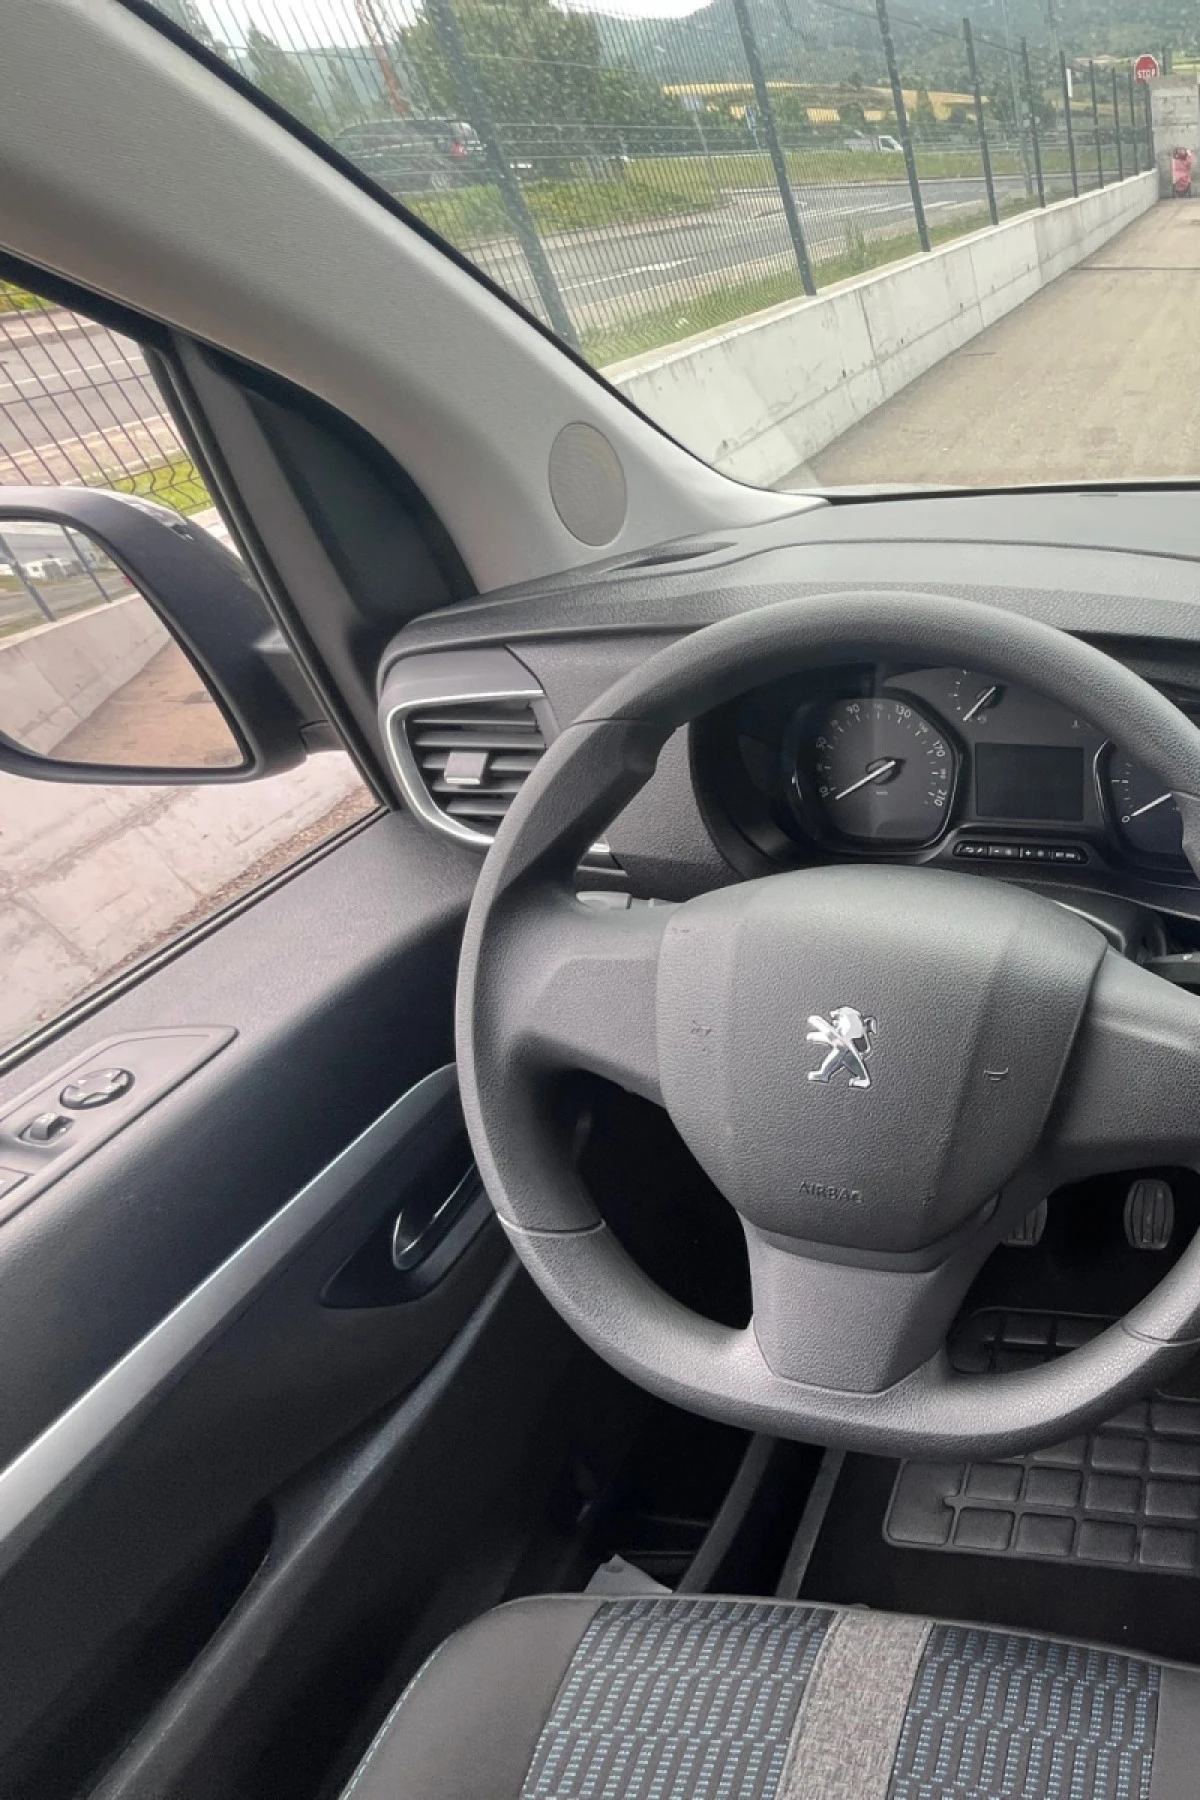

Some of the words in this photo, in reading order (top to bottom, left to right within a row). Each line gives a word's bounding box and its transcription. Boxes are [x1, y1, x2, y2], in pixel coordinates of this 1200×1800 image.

[1136, 69, 1156, 79] STOP
[895, 704, 912, 719] 130
[799, 1177, 863, 1204] AIRBAG
